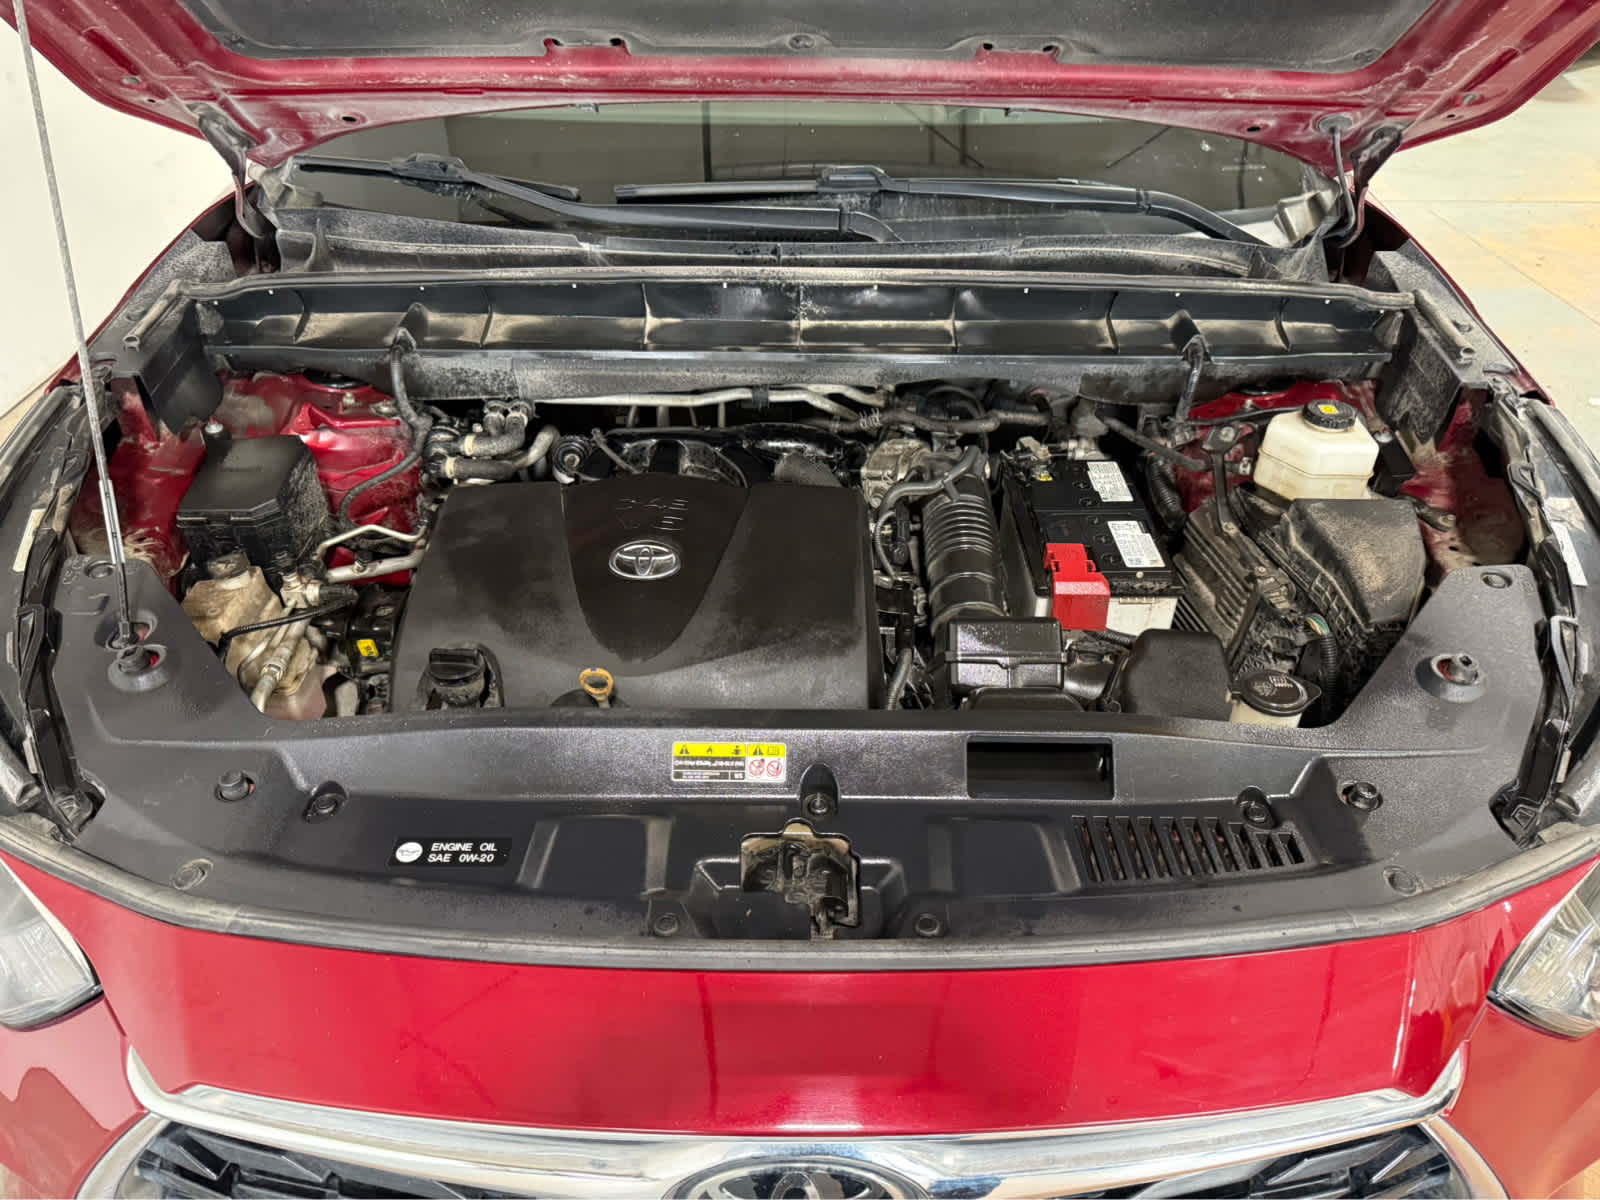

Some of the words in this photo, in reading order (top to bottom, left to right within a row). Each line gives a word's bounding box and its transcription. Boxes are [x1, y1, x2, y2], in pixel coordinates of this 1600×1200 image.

[431, 842, 474, 852] ENGINE
[479, 842, 498, 852] OIL
[427, 853, 453, 863] SAE
[458, 853, 495, 863] 0W-20
